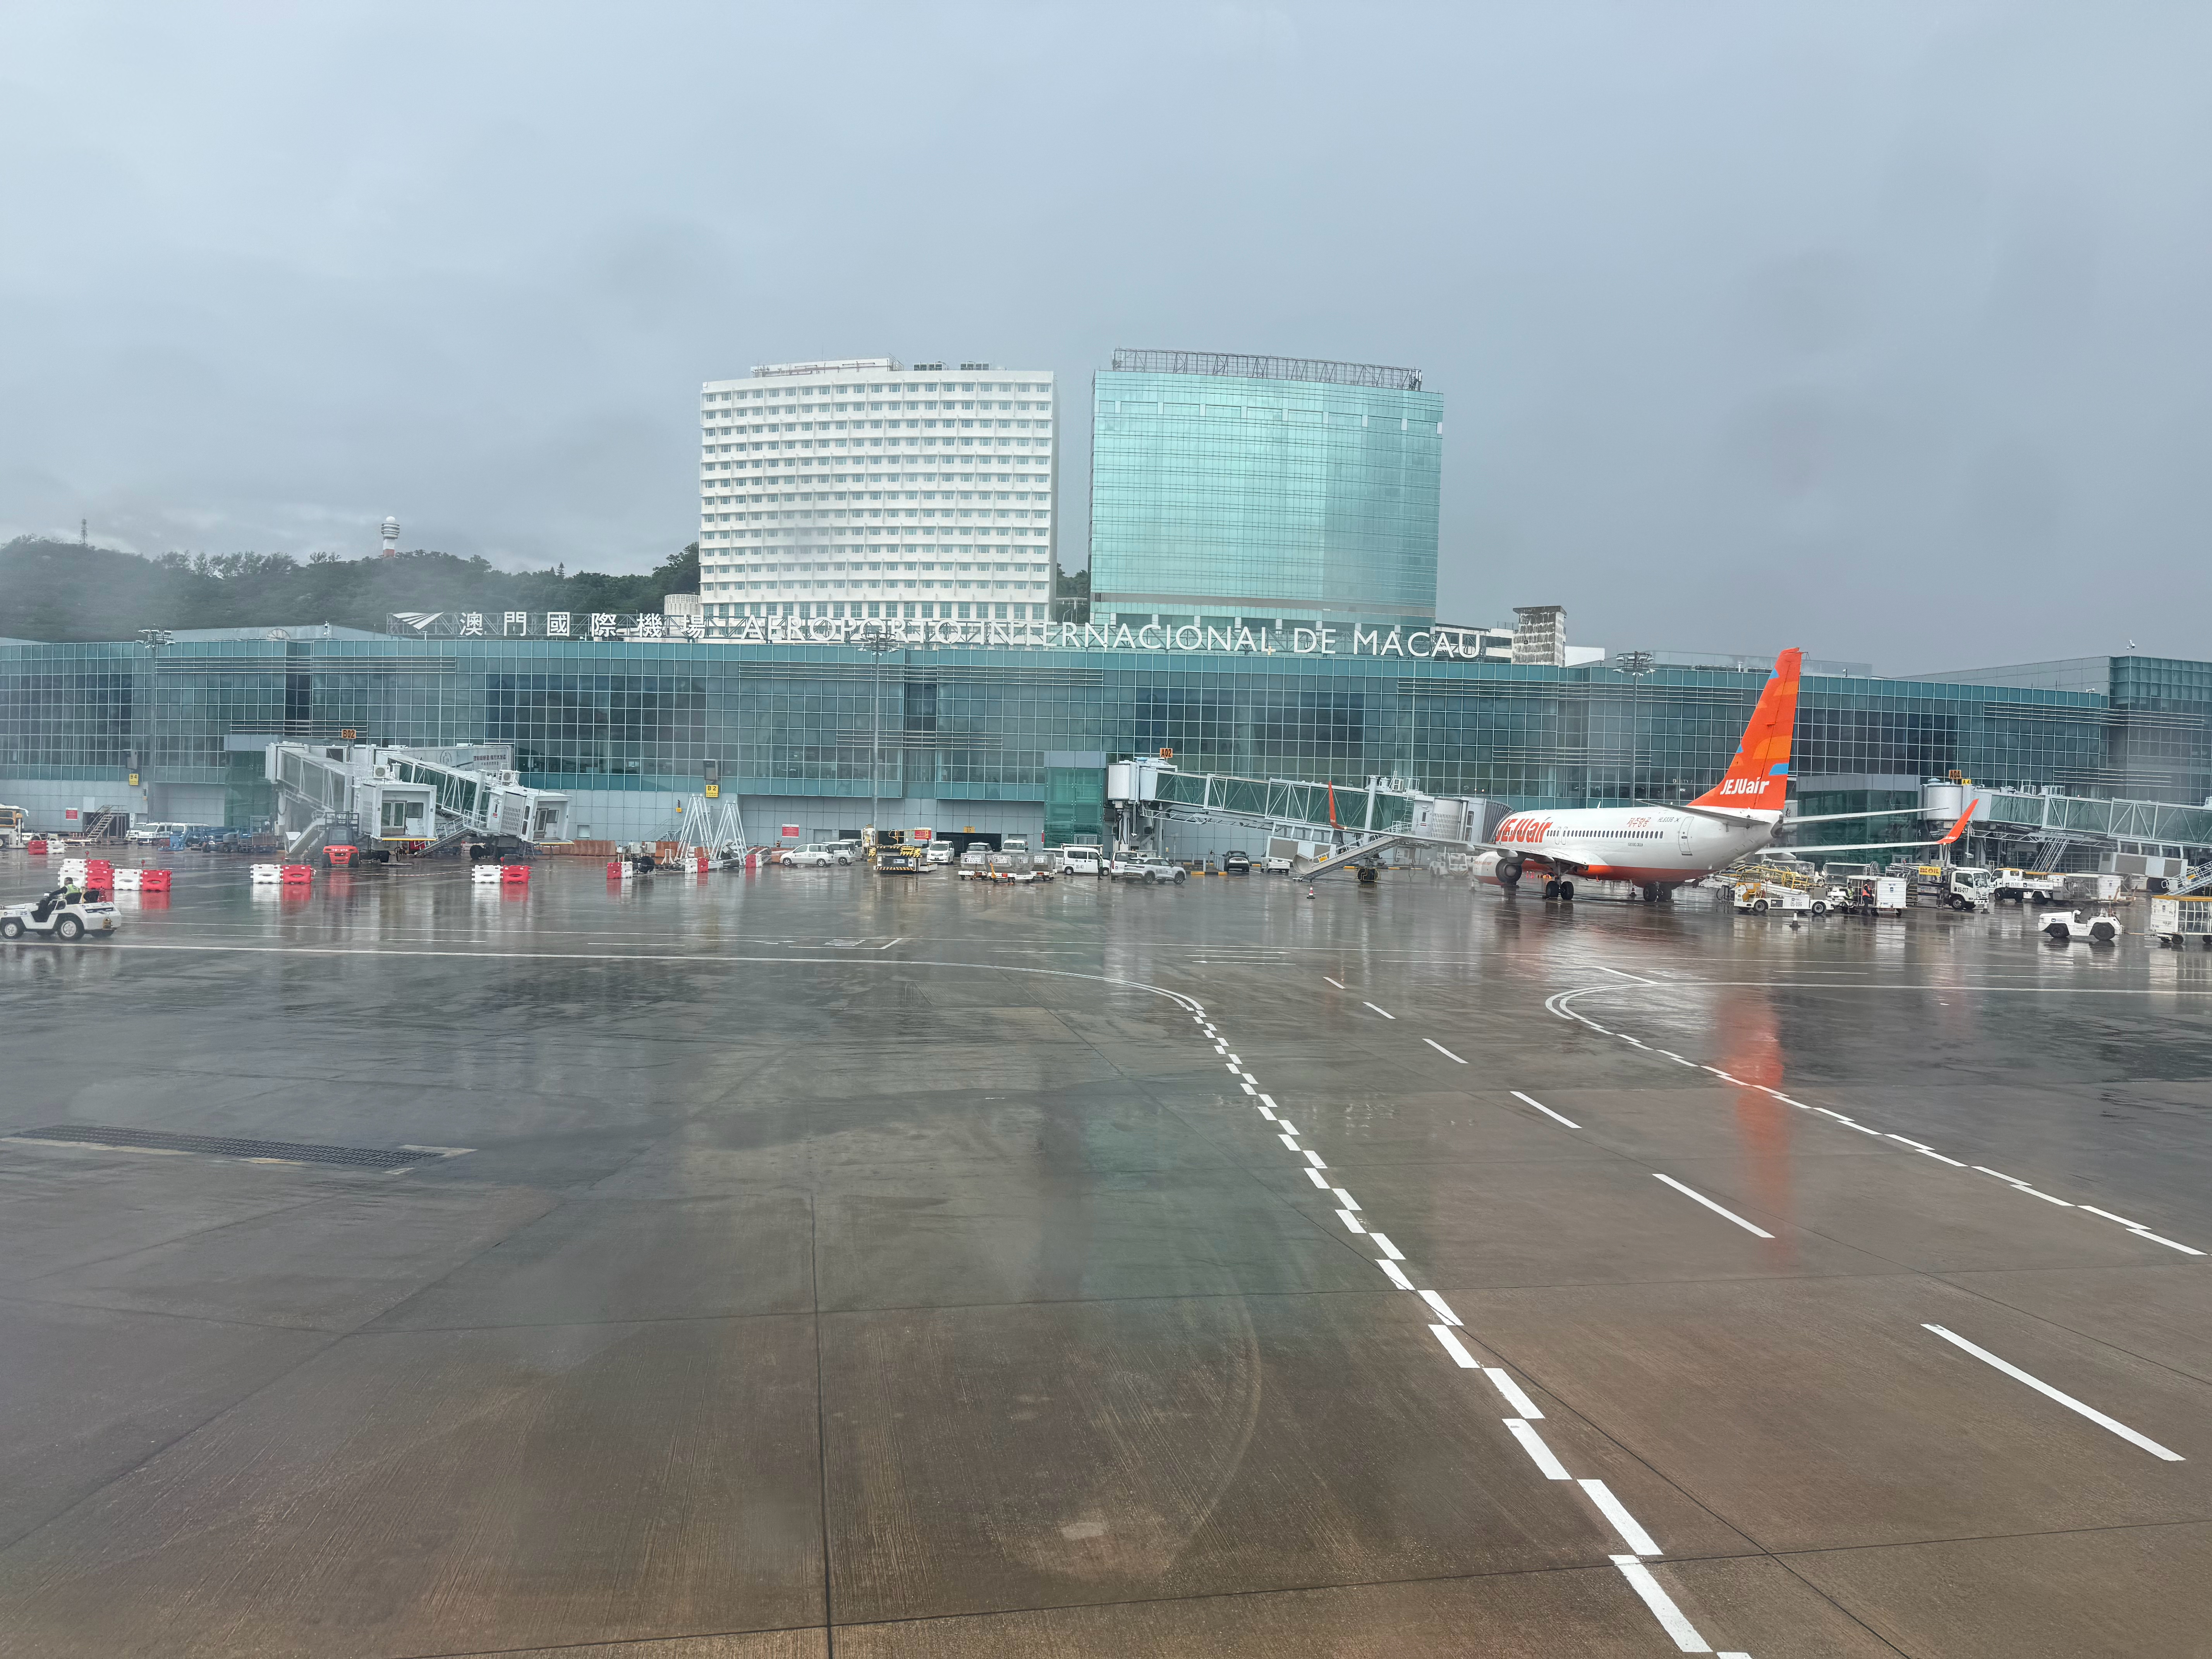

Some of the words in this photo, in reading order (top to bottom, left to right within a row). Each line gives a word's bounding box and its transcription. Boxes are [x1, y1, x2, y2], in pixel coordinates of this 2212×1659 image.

[460, 611, 706, 639] 澳門國際機場
[741, 615, 962, 644] AEROPORTO
[980, 620, 1275, 652] INTERNACIONAL
[1294, 627, 1336, 654] DE
[1354, 630, 1480, 658] MACAU
[343, 730, 355, 738] B02
[1161, 749, 1171, 757] A02
[1720, 777, 1770, 795] JEJUair
[1495, 817, 1553, 843] JEJUair
